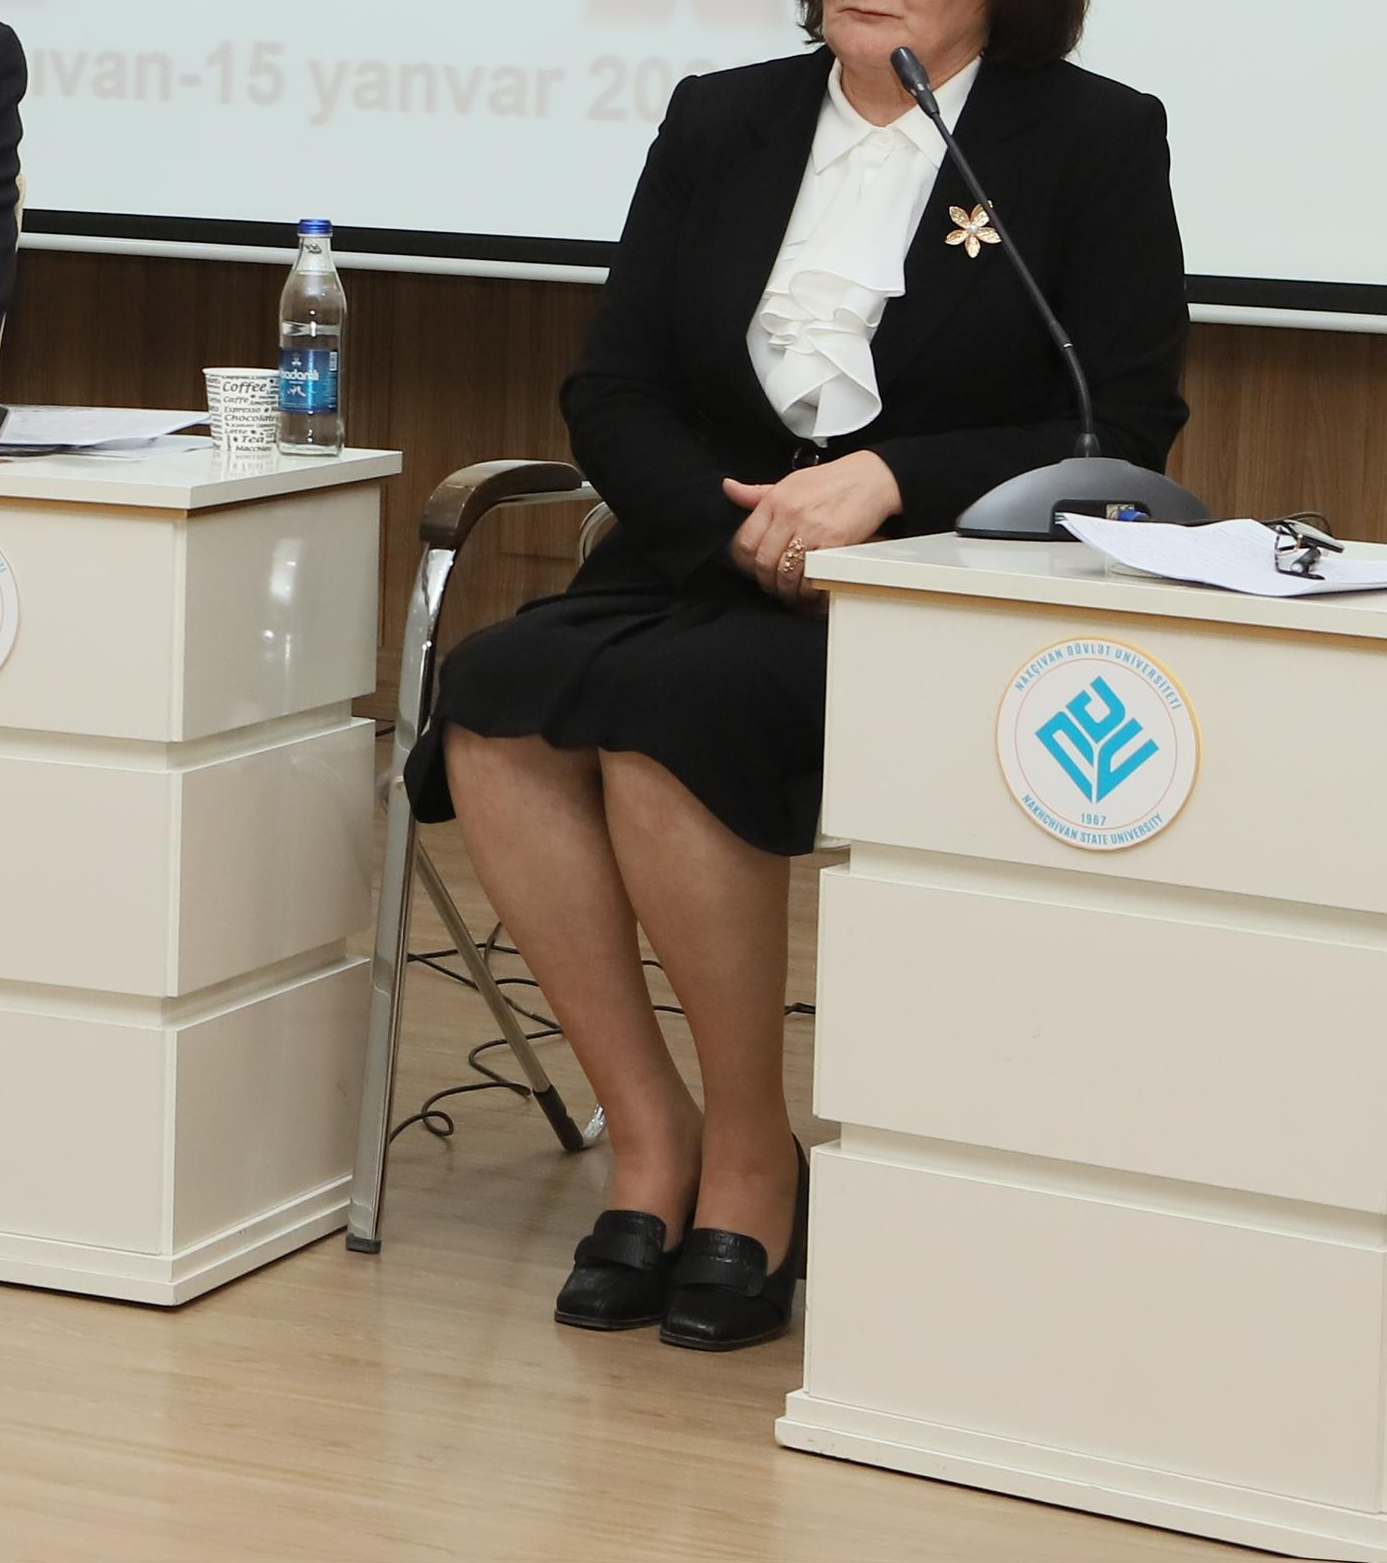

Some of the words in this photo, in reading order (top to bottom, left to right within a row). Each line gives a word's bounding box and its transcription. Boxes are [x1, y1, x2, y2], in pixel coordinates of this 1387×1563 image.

[306, 52, 566, 127] yanvar
[586, 51, 722, 126] 20
[222, 380, 267, 394] Coffee
[241, 435, 265, 443] Tea
[1021, 793, 1078, 841] NAKHCHIVAN
[1080, 831, 1109, 846] STATE
[1110, 812, 1164, 846] UNIVERSITY
[1081, 812, 1107, 827] 1967
